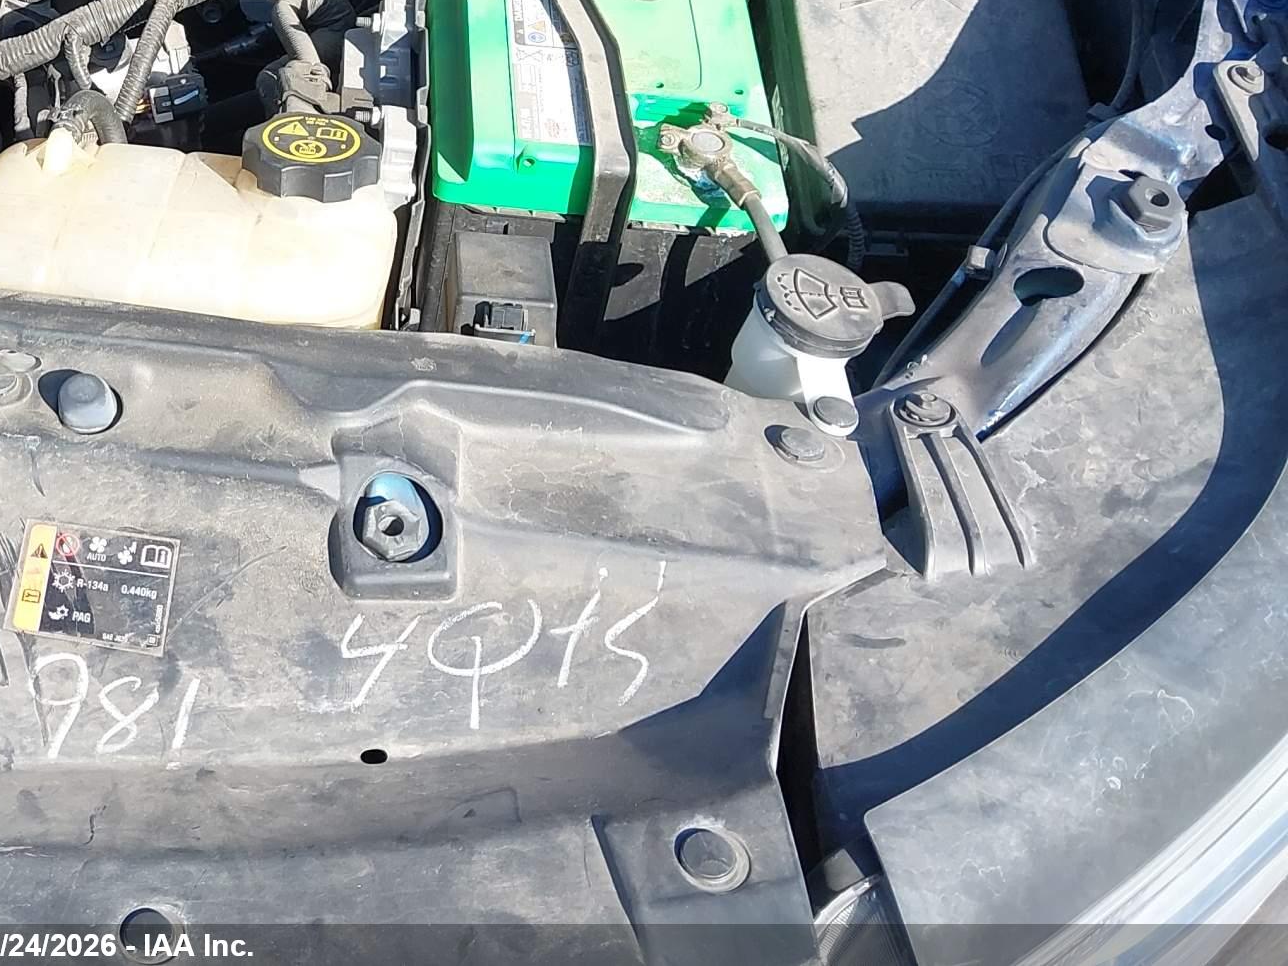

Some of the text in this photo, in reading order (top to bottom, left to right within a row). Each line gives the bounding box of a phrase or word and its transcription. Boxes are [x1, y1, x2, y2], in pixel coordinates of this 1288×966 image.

[86, 552, 107, 563] AUTO
[76, 578, 158, 601] R-134a 0.440kg
[72, 610, 92, 624] PAG
